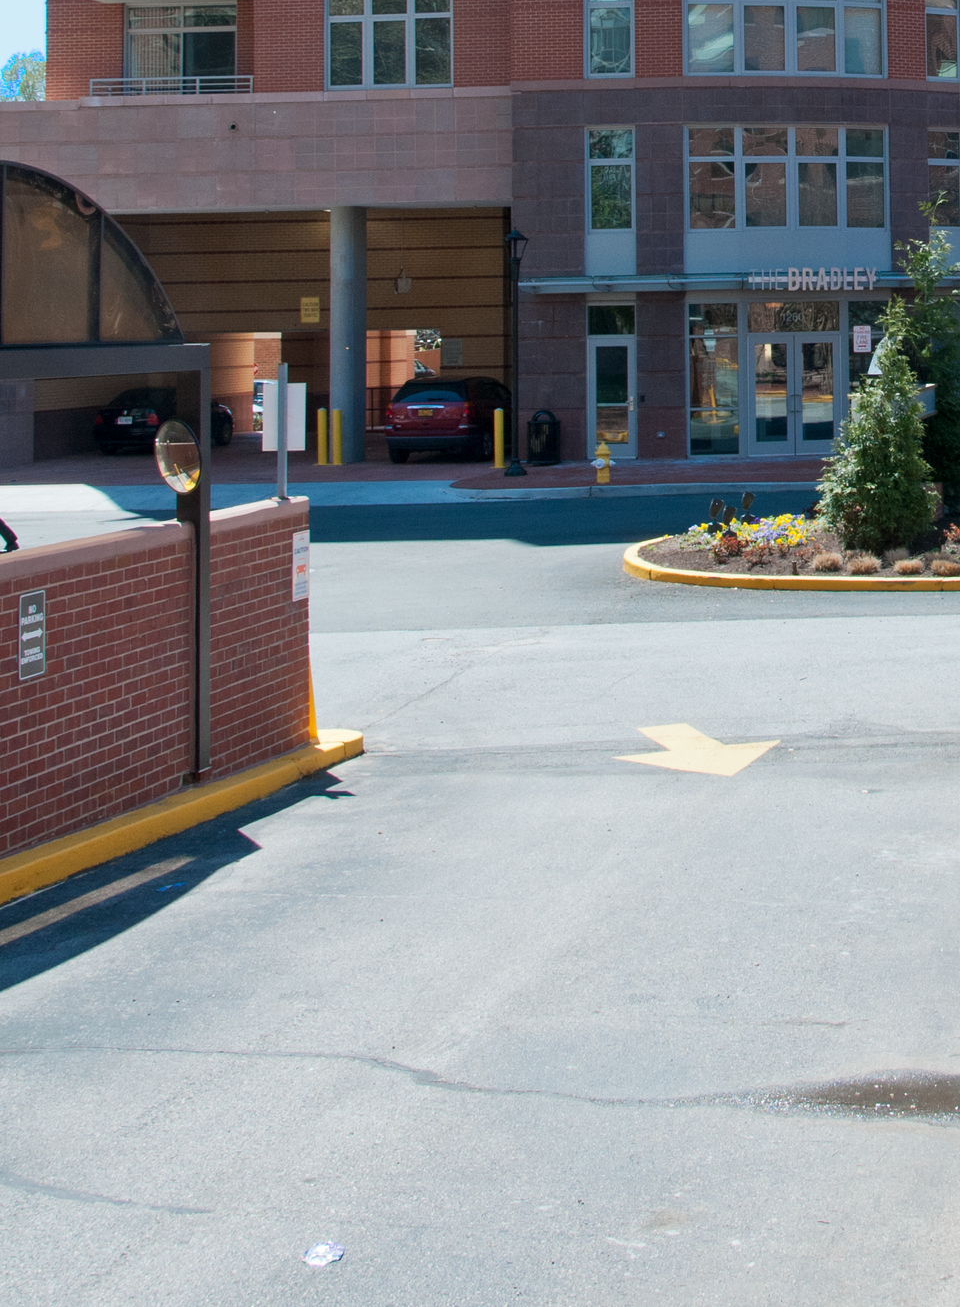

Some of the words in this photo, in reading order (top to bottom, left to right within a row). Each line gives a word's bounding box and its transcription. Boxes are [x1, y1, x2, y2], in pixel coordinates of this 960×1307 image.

[750, 269, 783, 290] THE
[788, 267, 877, 291] BRADLEY
[783, 312, 804, 322] 1260
[28, 604, 37, 614] NO
[21, 613, 43, 625] PARKING
[24, 646, 40, 656] TOWING
[21, 653, 43, 664] ENFORCED
